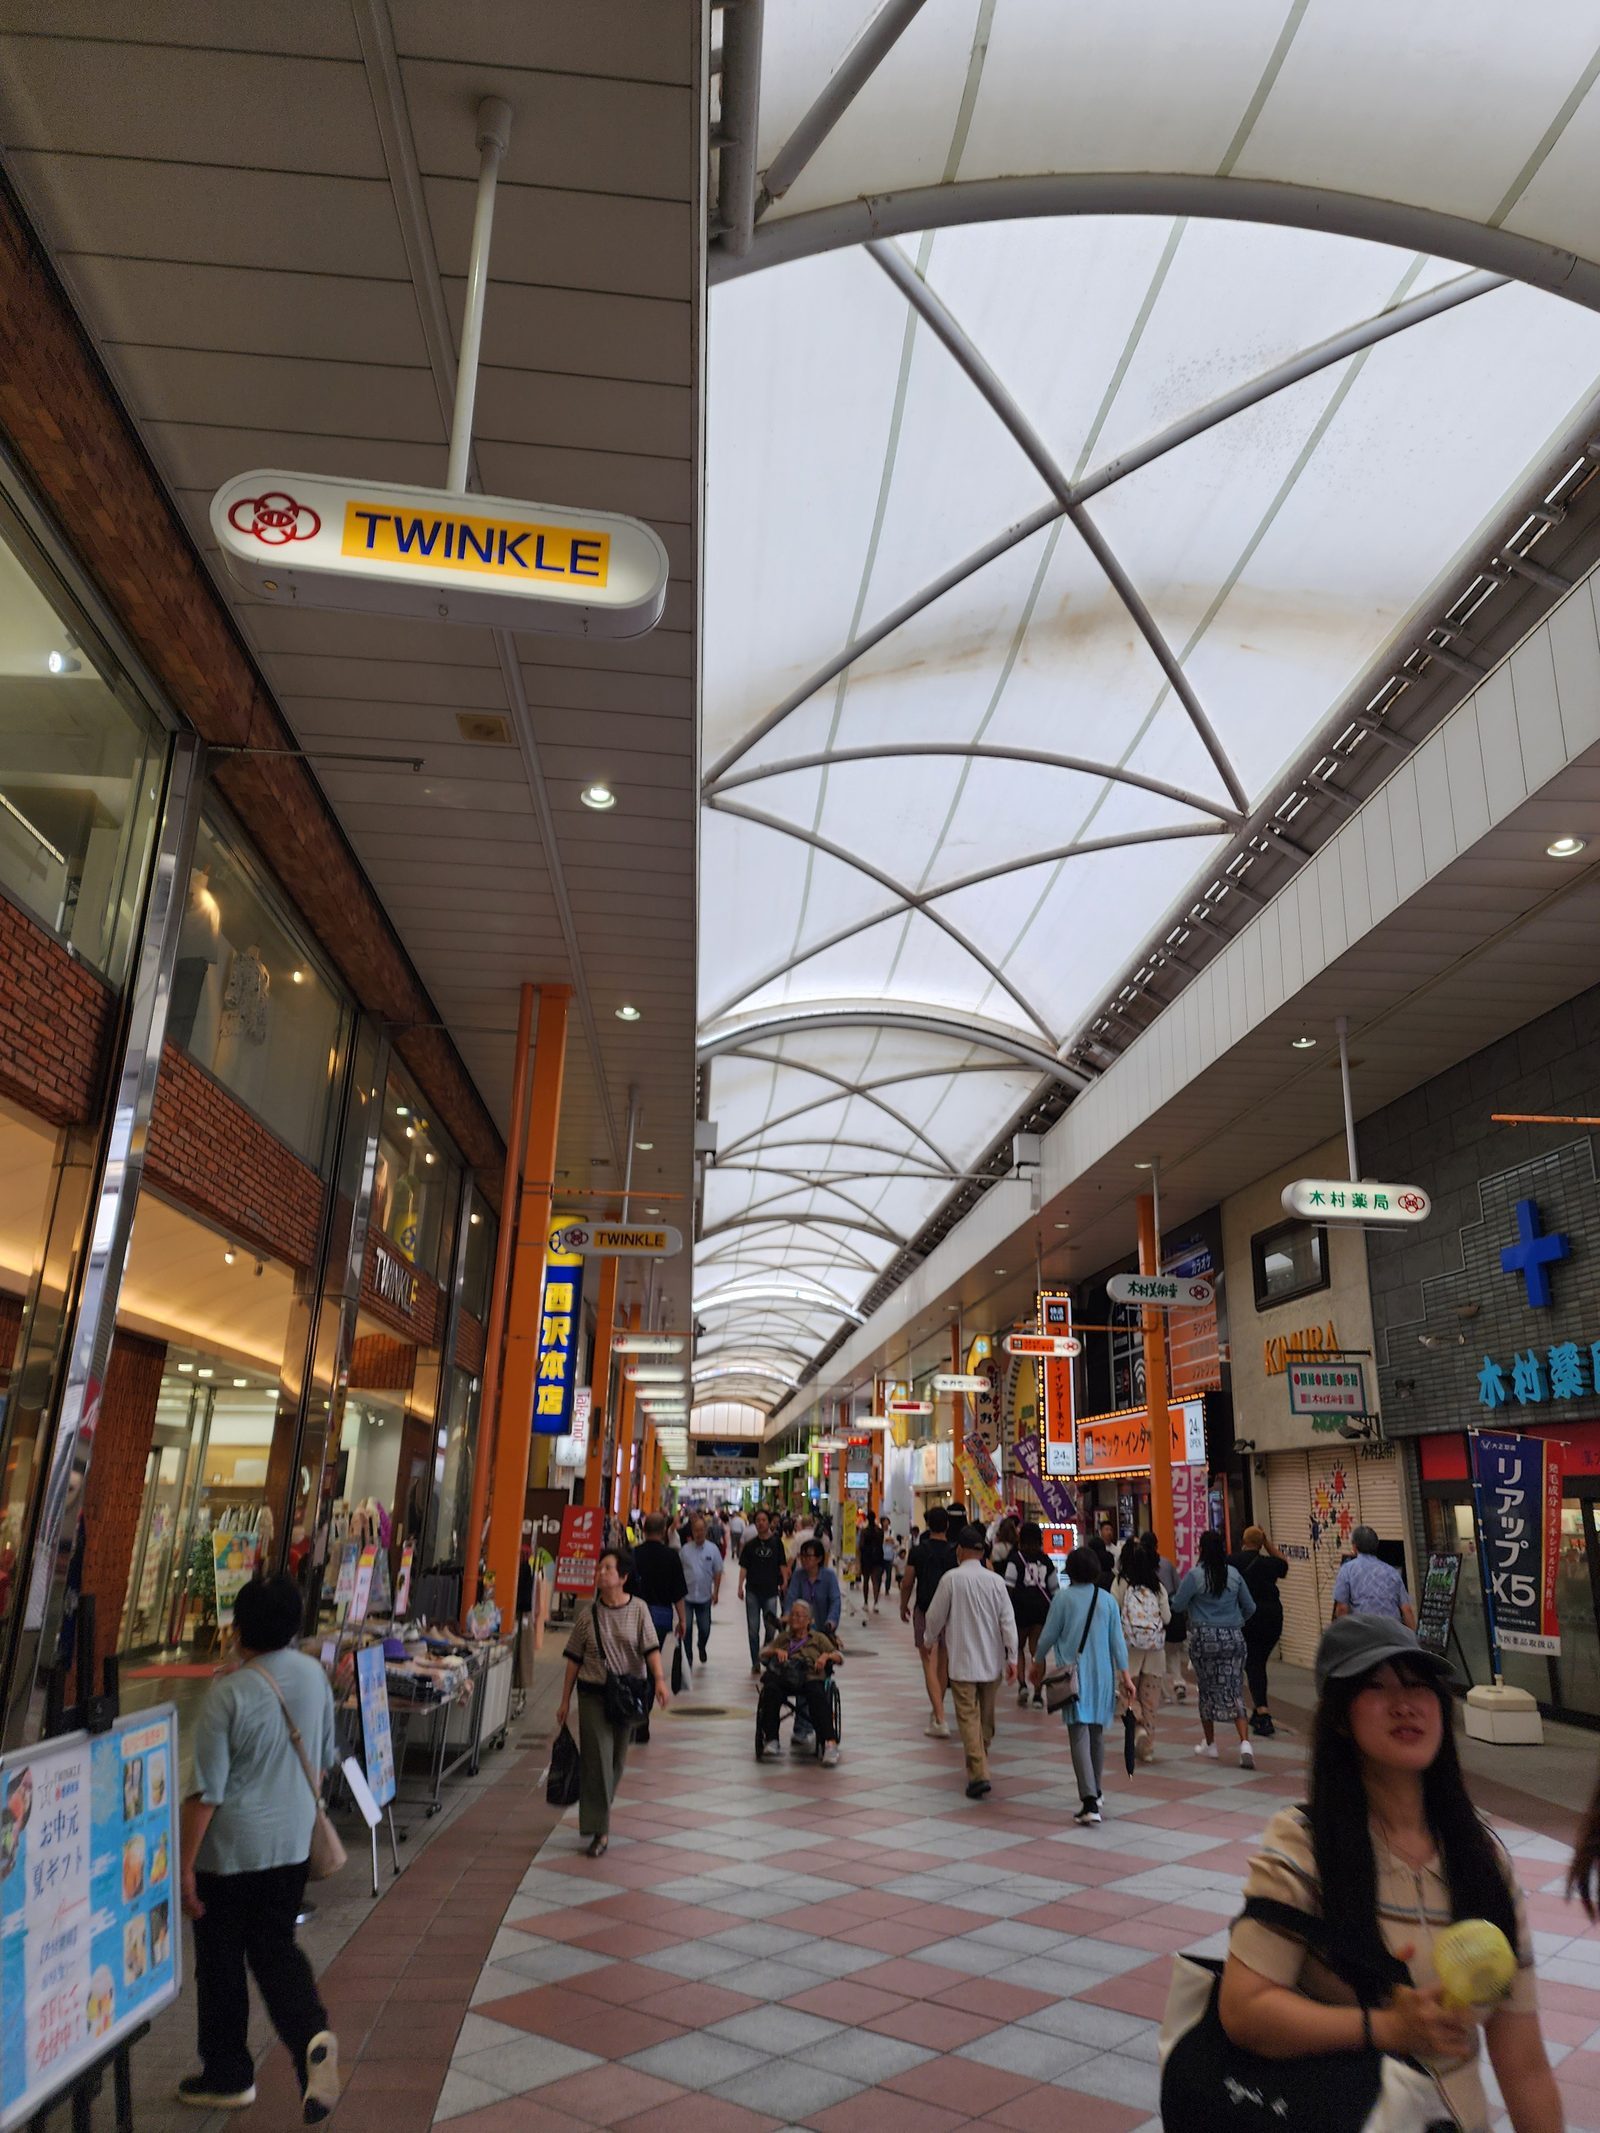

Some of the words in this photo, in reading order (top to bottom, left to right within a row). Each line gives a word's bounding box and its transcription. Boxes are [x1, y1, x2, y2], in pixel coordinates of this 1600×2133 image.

[354, 510, 602, 577] TWINKLE
[1309, 1189, 1390, 1211] 木村薬局
[599, 1231, 665, 1248] TWINKLE
[1191, 1254, 1212, 1276] カラオケ
[374, 1246, 418, 1319] TWINKLE
[1127, 1281, 1178, 1299] 木村美術堂
[536, 1282, 574, 1415] 西沢本店
[1264, 1320, 1342, 1377] KIMURA
[1477, 1339, 1600, 1409] 木村薬
[1172, 1467, 1190, 1575] カラオケ
[1494, 1457, 1530, 1568] リアップ
[1491, 1570, 1536, 1608] X5
[40, 1804, 79, 1849] お中元
[32, 1845, 83, 1899] 夏ギフト
